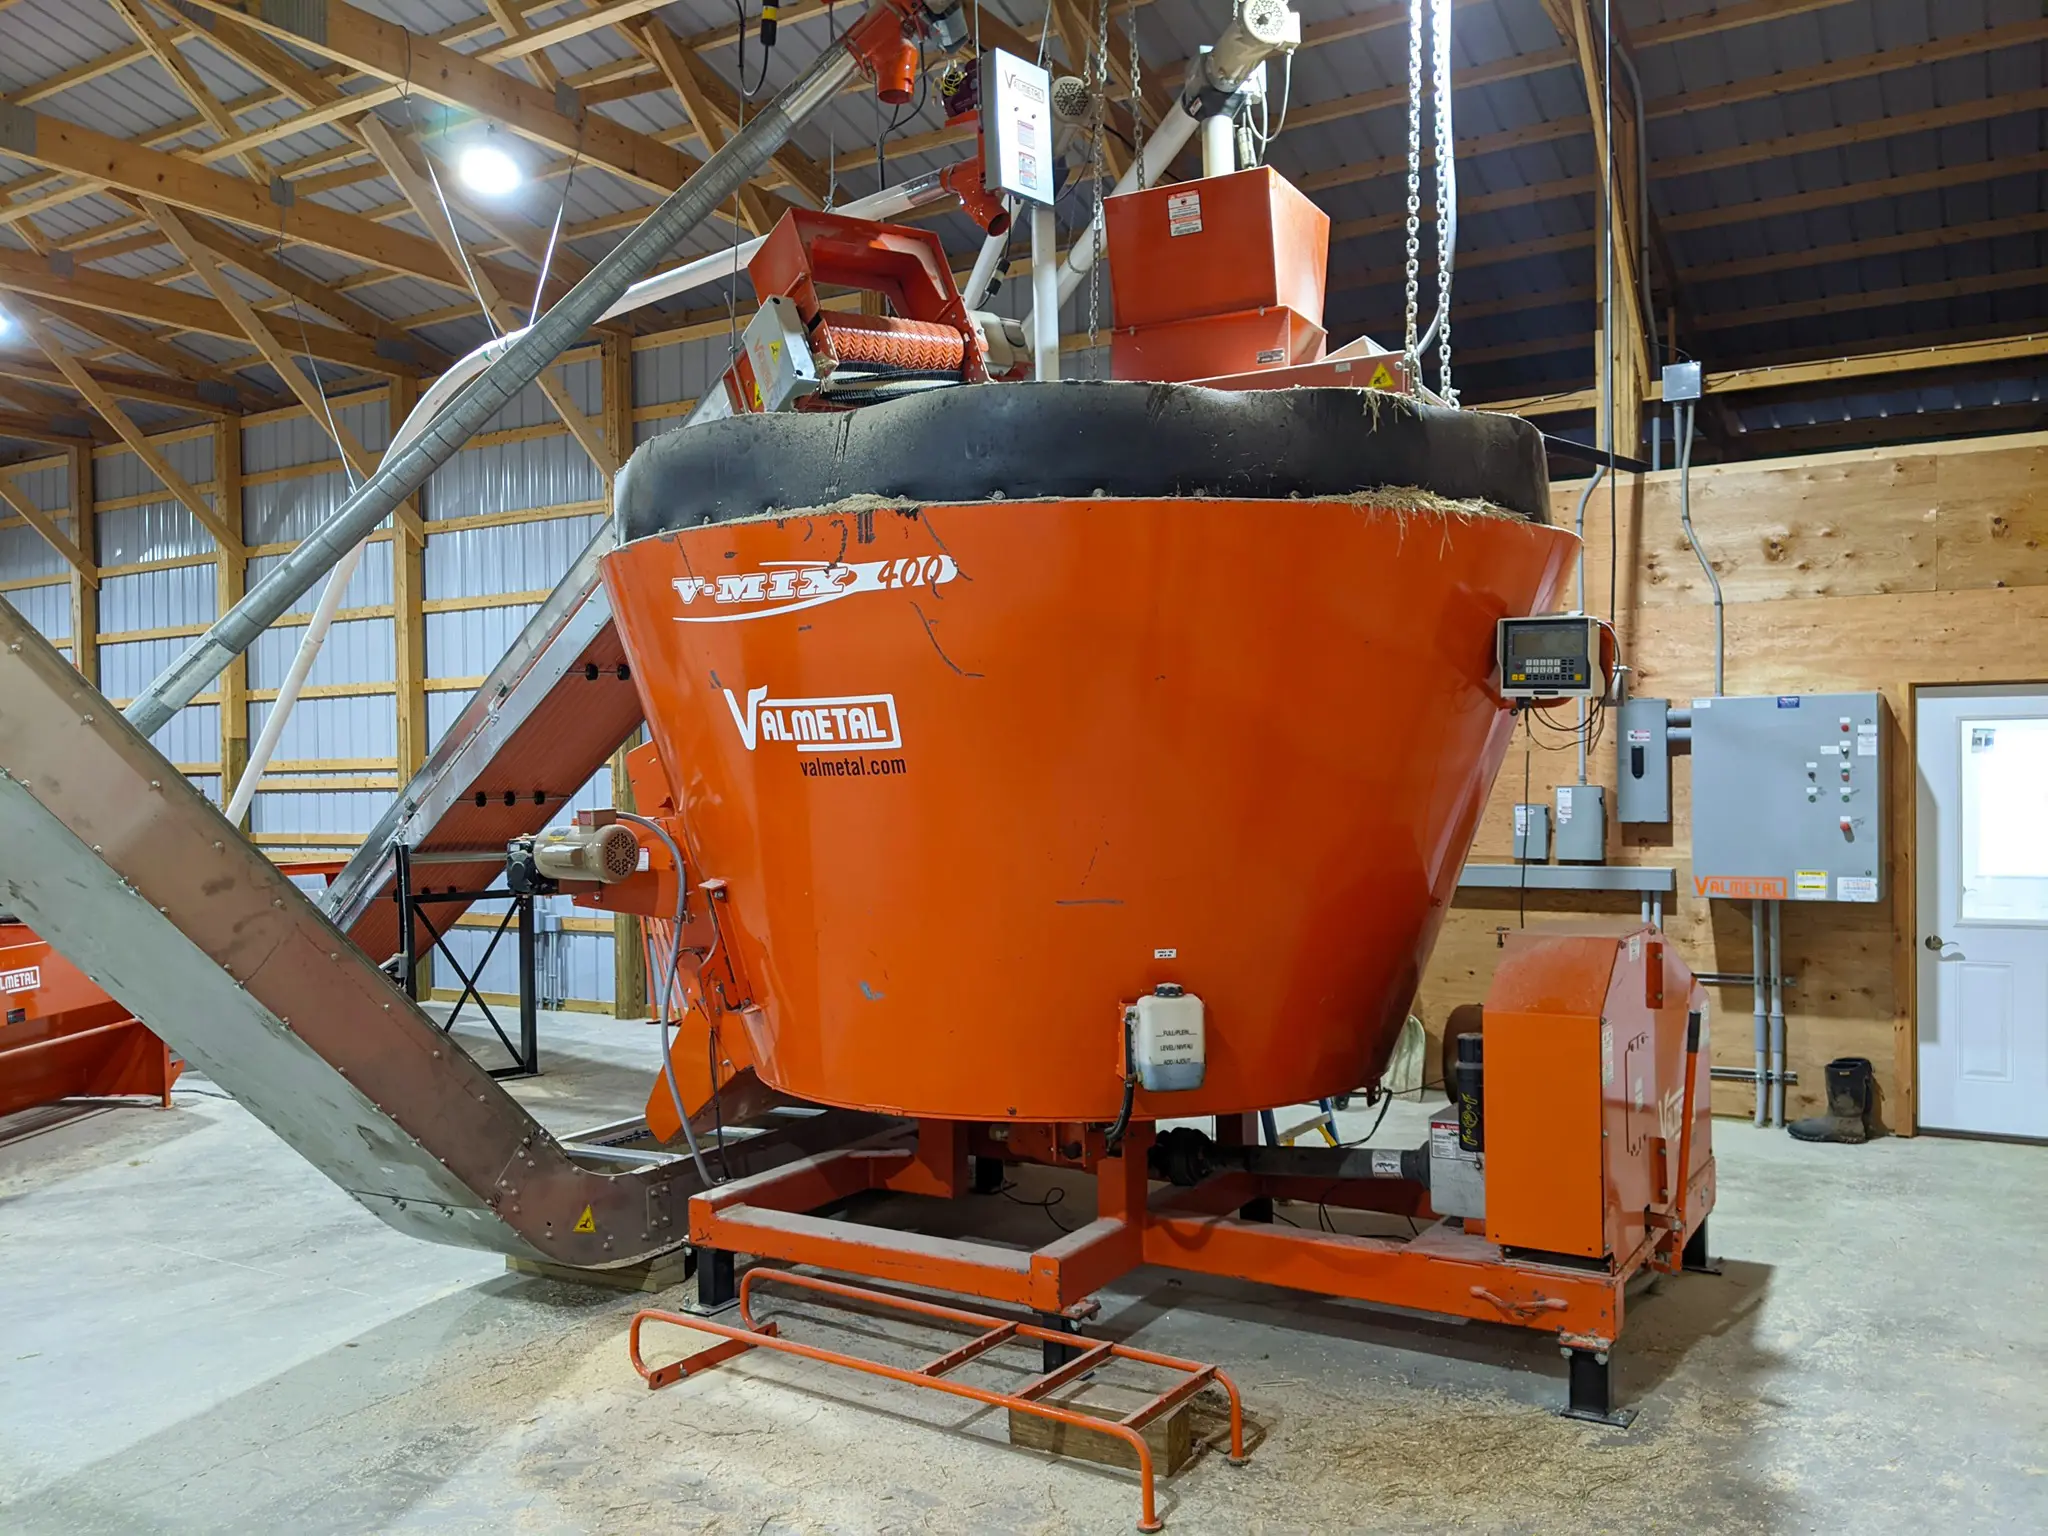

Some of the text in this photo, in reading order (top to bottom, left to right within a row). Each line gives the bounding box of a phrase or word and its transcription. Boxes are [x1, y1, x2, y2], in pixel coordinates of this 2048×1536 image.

[671, 557, 944, 605] V-MIX 400
[723, 684, 888, 752] VALMETAL
[799, 757, 907, 778] valmetal.com
[1693, 875, 1779, 897] VALMETAL
